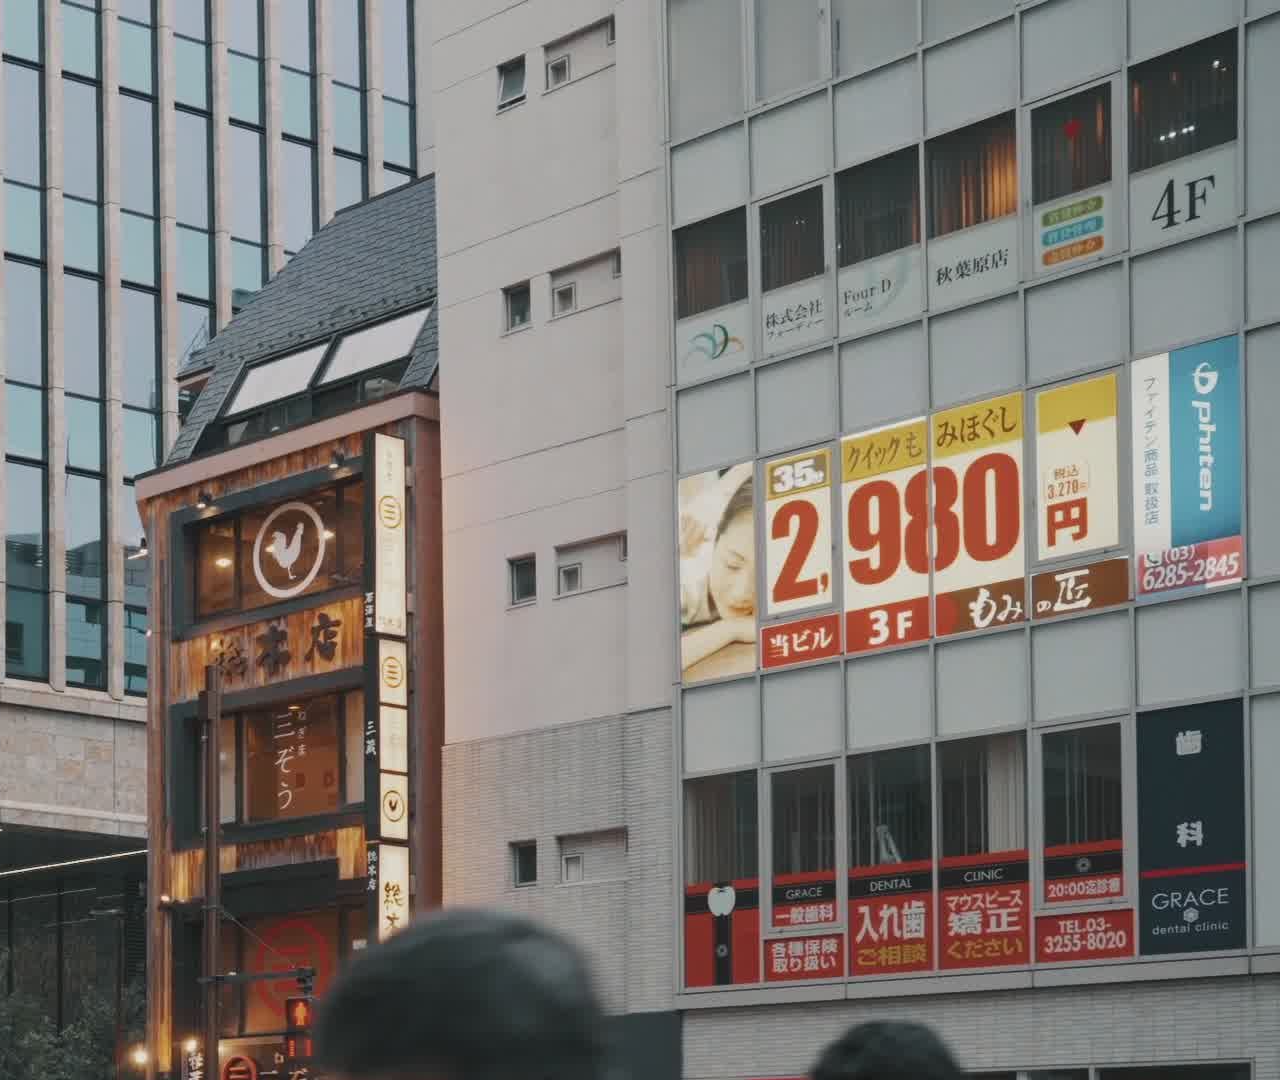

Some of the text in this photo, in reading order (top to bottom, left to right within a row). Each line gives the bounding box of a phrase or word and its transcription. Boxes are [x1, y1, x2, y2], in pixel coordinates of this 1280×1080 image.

[1152, 175, 1216, 230] 4F
[936, 248, 1009, 286] 秋葉原店
[765, 299, 824, 329] 株式会社
[1192, 400, 1216, 512] phiten
[1143, 552, 1240, 590] 6285-2845
[969, 569, 1092, 628] もみの匠
[769, 627, 833, 658] 当ビル
[273, 712, 295, 810] 三ぞう
[786, 868, 1004, 900] GRACE DENTAL CLINIC
[945, 889, 1024, 911] マウスピース
[1151, 888, 1229, 910] GRACE
[775, 904, 834, 924] 一般歯科
[855, 900, 926, 944] 入れ歯
[947, 907, 1023, 936] 矯正
[1058, 917, 1113, 935] TEL.03-
[1151, 920, 1229, 935] dental clinic
[772, 937, 839, 960] 各種保険
[856, 943, 928, 967] ご相談
[946, 937, 1024, 959] ください
[1044, 931, 1127, 954] 3255-8020
[772, 954, 837, 974] 取り扱い
